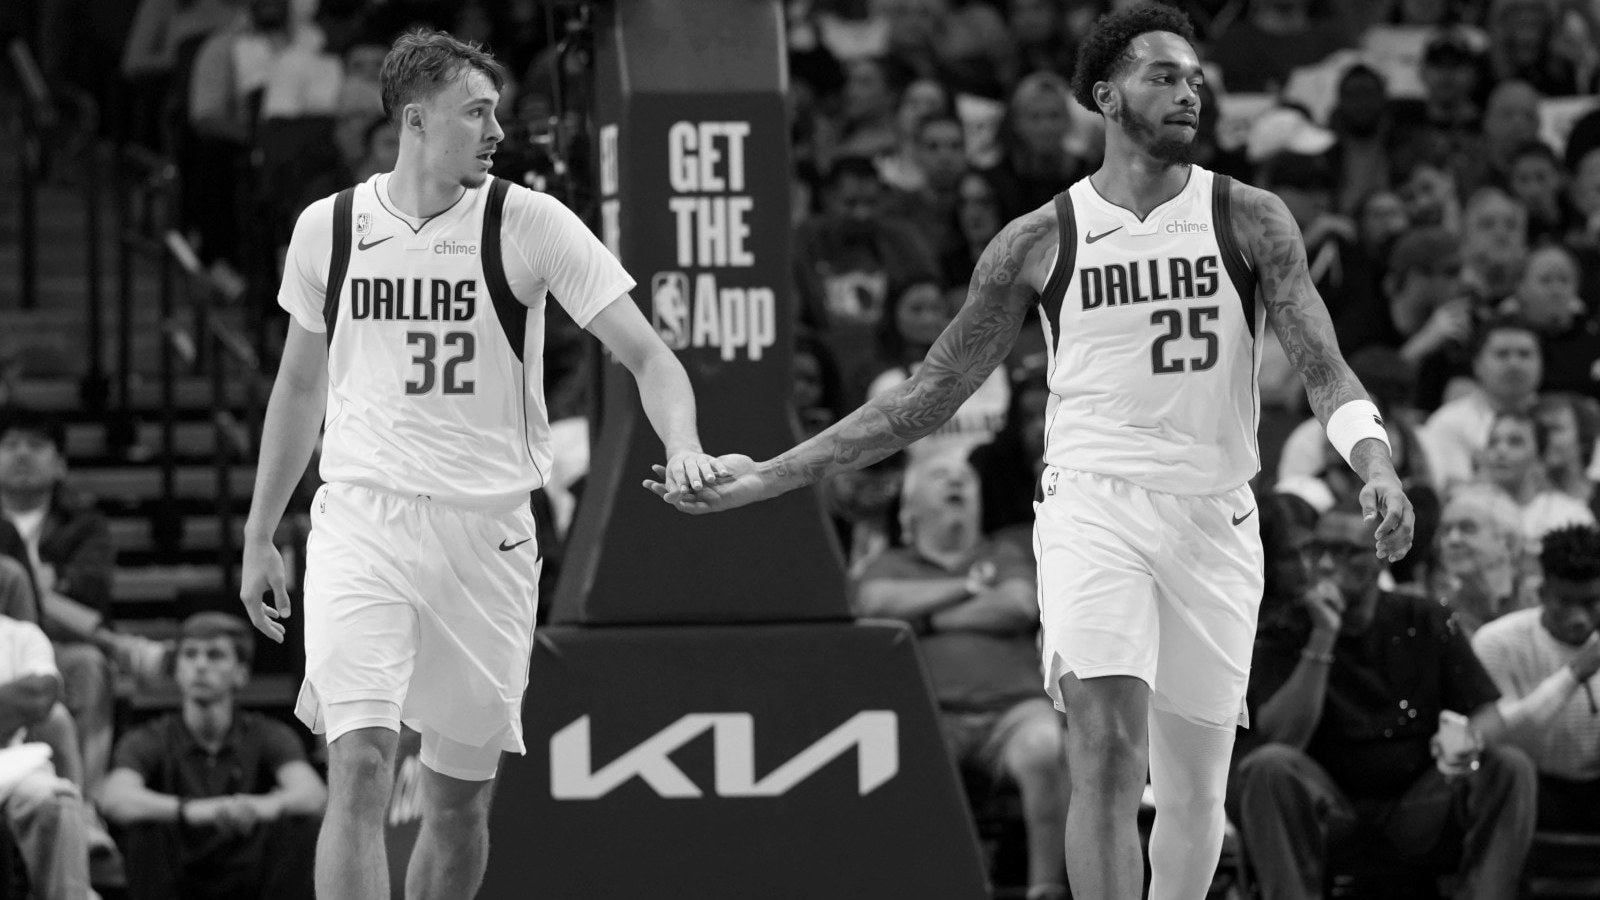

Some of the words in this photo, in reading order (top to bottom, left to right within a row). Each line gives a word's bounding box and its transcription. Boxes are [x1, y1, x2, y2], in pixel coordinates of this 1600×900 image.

[668, 121, 750, 193] GET
[433, 241, 477, 255] chime
[669, 197, 755, 267] THE
[1165, 220, 1209, 234] chime
[351, 277, 477, 321] DALLAS
[1080, 255, 1219, 312] DALLAS
[692, 273, 776, 361] App
[1150, 306, 1219, 375] 25
[405, 330, 476, 396] 32
